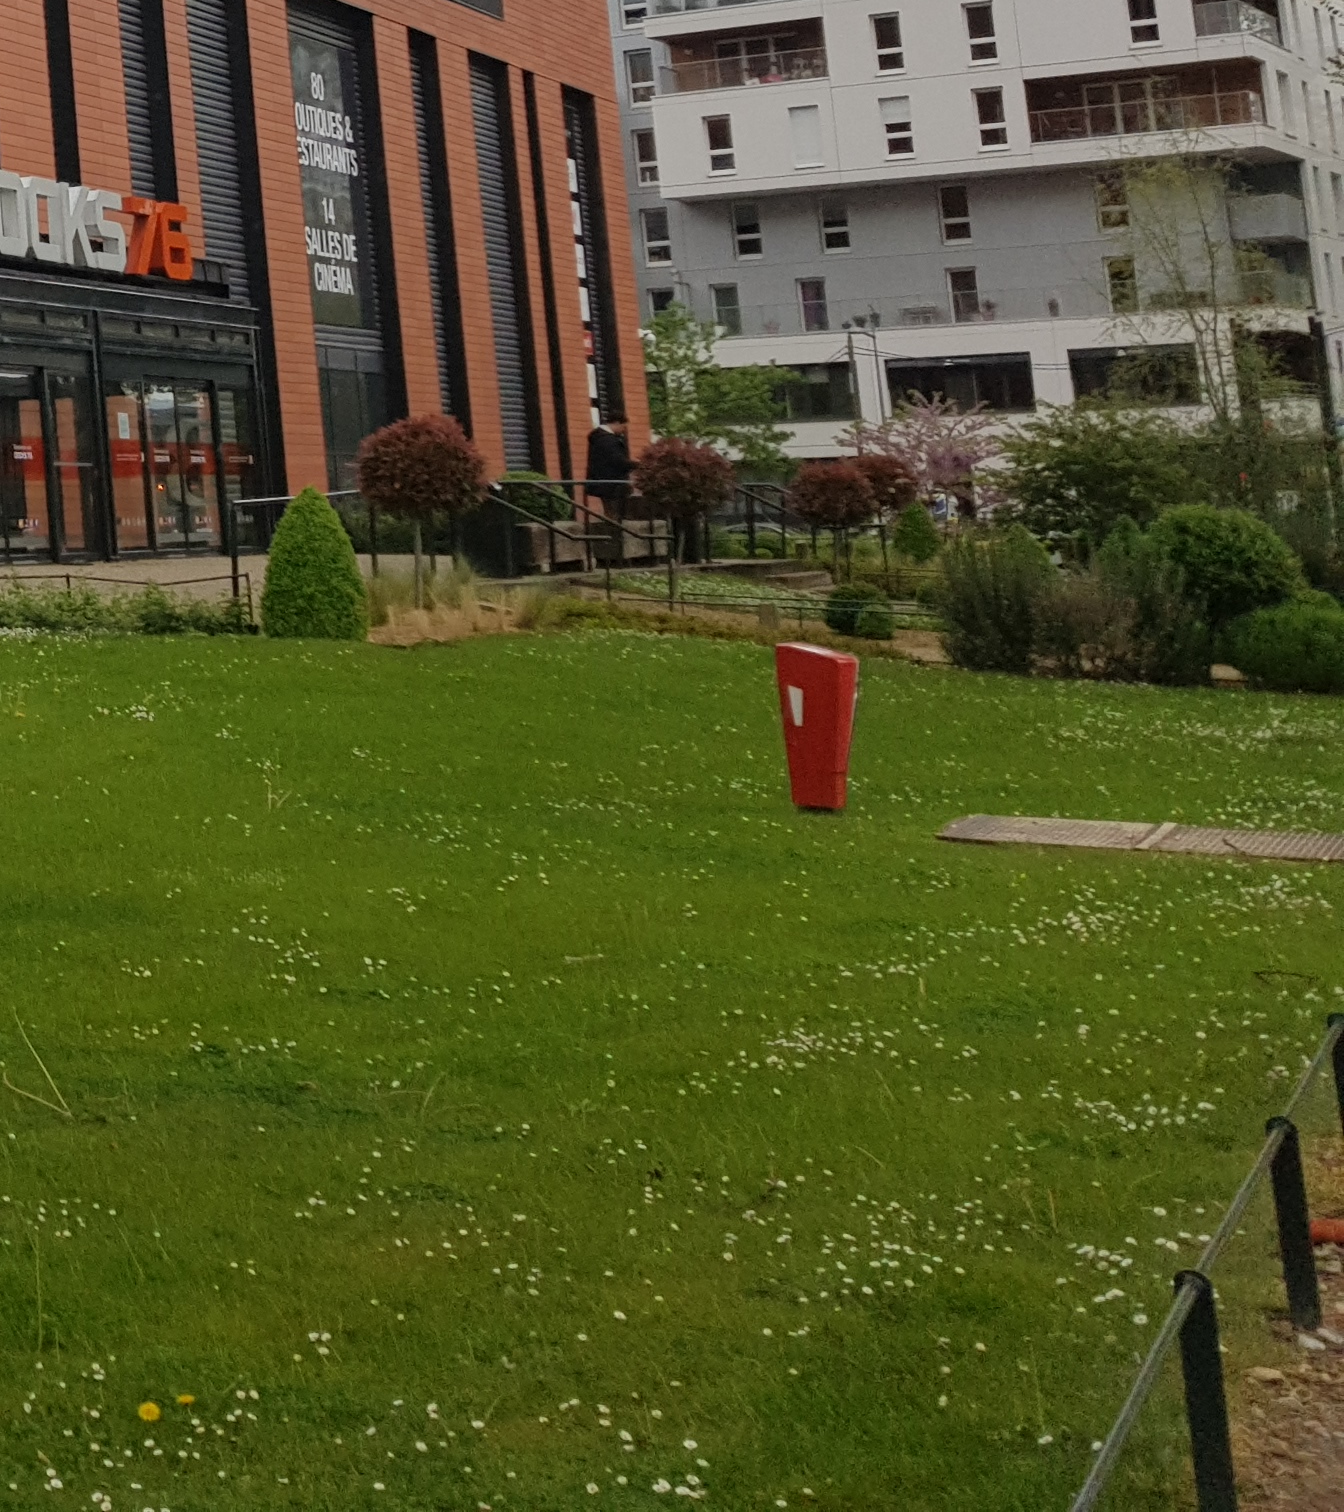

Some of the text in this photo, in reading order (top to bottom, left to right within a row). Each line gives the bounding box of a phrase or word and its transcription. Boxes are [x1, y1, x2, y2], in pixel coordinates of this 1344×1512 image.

[310, 72, 325, 101] 80
[294, 101, 355, 143] OUTIQUES &
[296, 135, 359, 176] ESTAURANTS
[321, 197, 336, 225] 14
[304, 225, 358, 263] SALLES DE
[314, 259, 355, 296] CINÉMA
